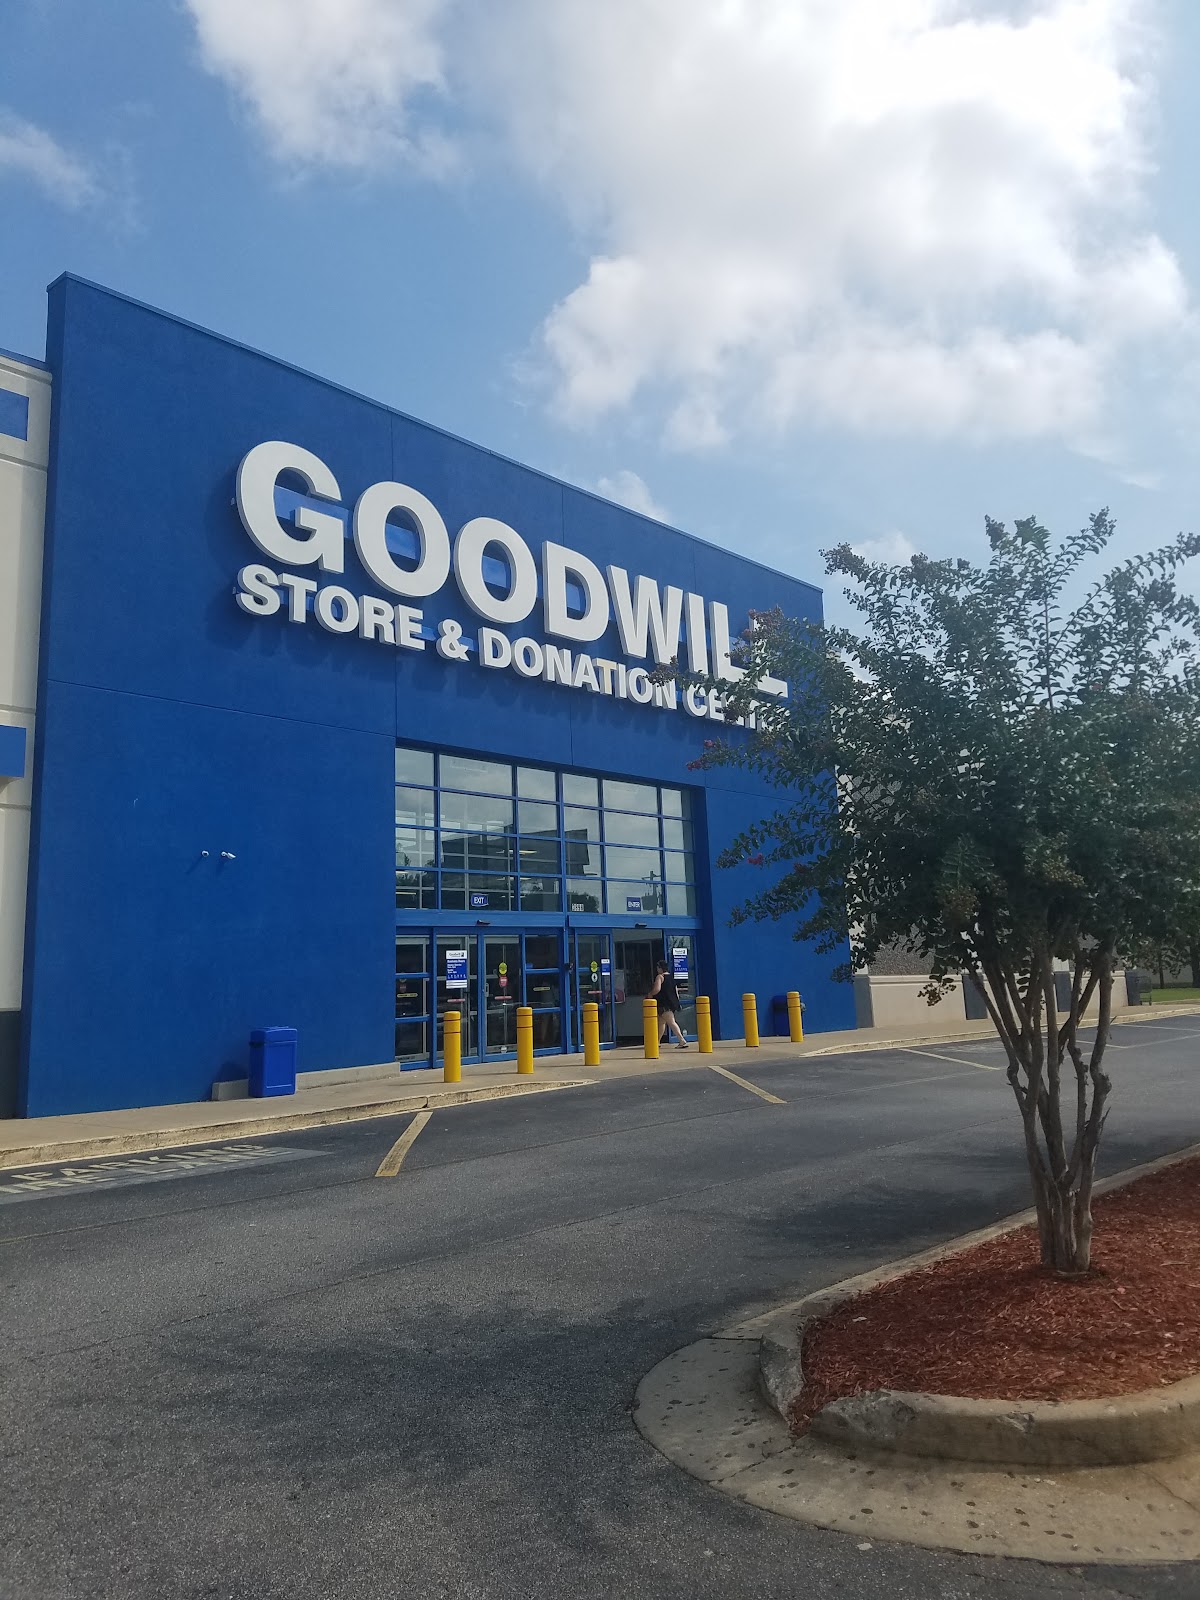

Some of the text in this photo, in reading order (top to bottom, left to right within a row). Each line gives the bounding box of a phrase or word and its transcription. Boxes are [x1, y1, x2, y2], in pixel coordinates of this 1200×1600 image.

[236, 563, 425, 651] STORE
[437, 619, 470, 662] &
[478, 627, 677, 710] DONATION
[473, 896, 485, 905] EXIT
[11, 1144, 265, 1181] PARKING
[127, 1149, 294, 1175] LANE
